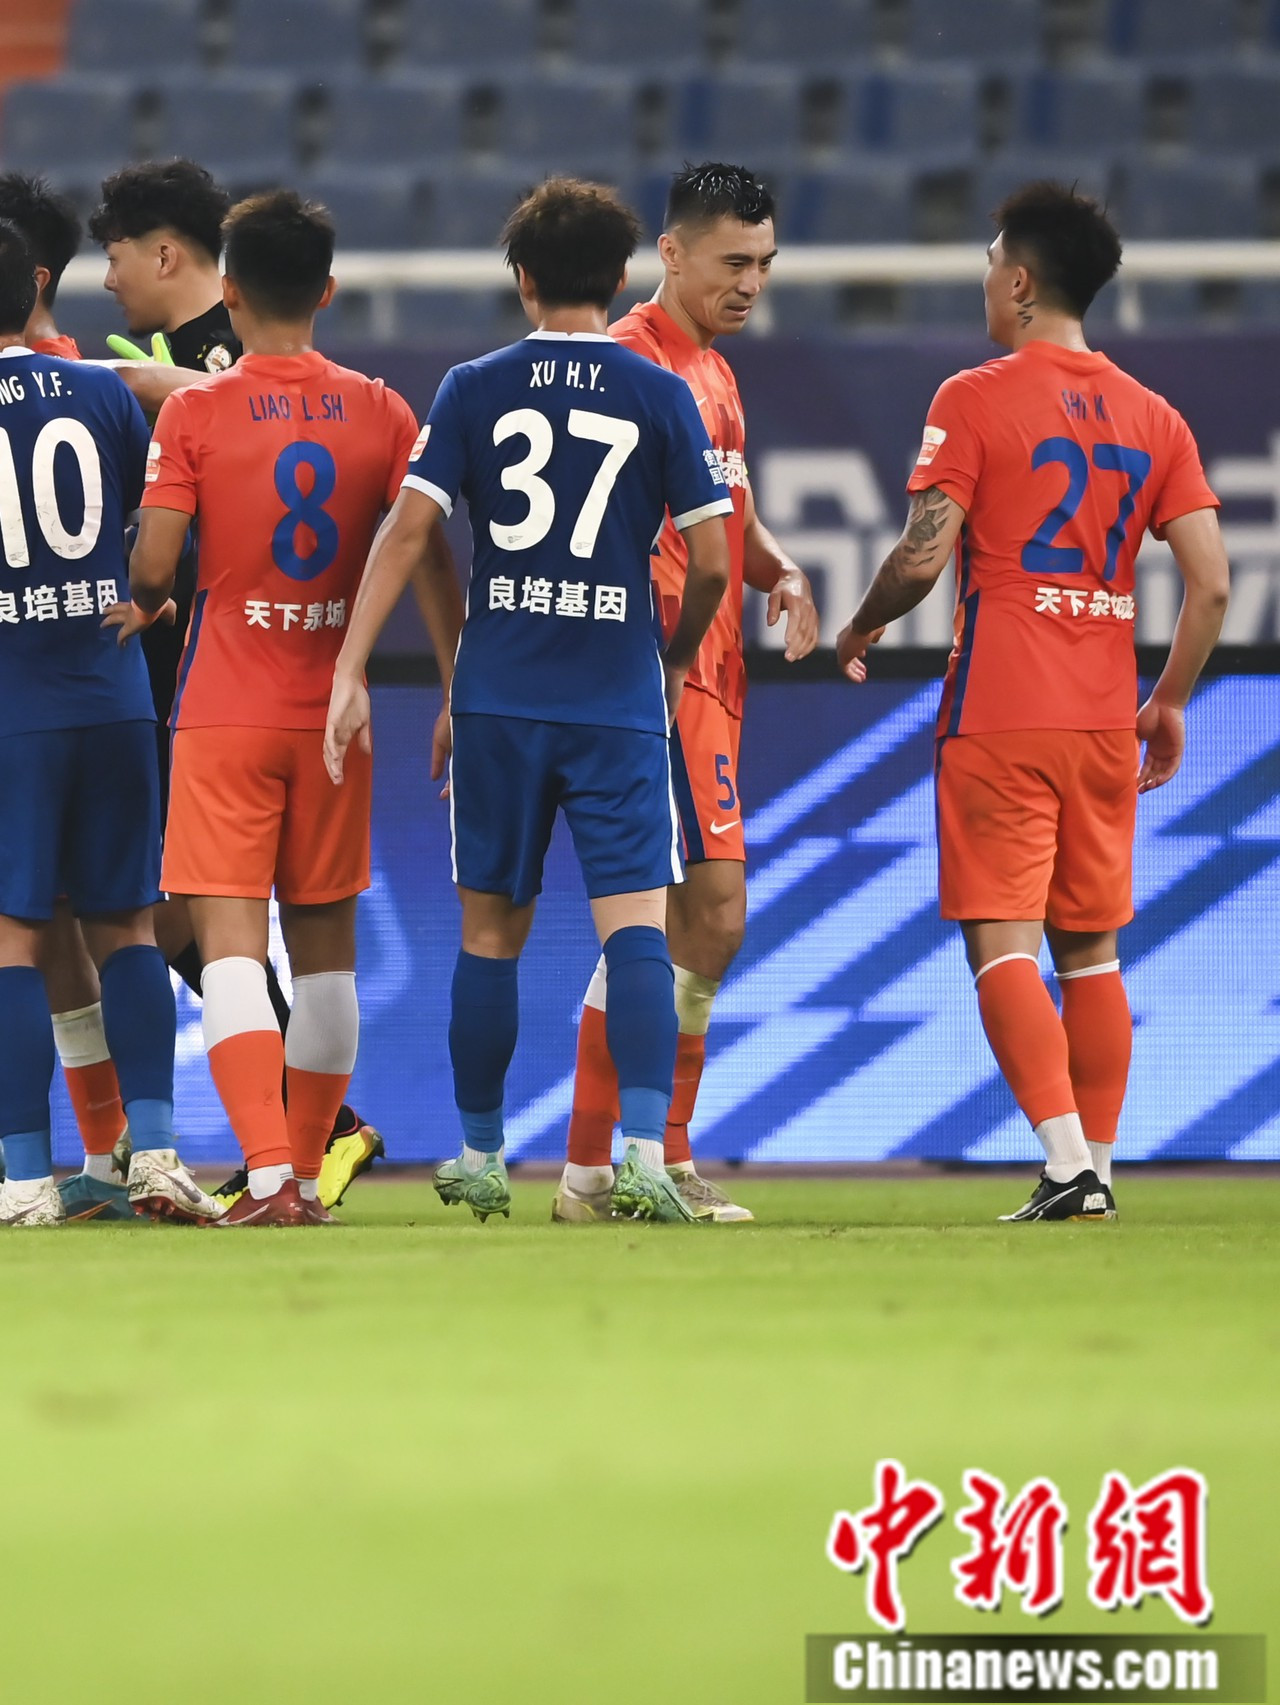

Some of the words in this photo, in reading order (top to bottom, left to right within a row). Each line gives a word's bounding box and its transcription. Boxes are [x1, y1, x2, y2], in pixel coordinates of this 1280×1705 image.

[31, 371, 73, 398] Y.F.
[529, 360, 556, 388] XU
[565, 360, 605, 393] H.Y.
[248, 395, 291, 422] LIAO
[1061, 388, 1087, 421] SHI
[489, 408, 640, 559] 37
[271, 440, 339, 581] 8
[1021, 436, 1152, 582] 27
[244, 598, 347, 632] 天下泉城
[488, 575, 627, 623] 良培基因
[1034, 586, 1136, 621] 天下泉城
[715, 754, 736, 810] 5
